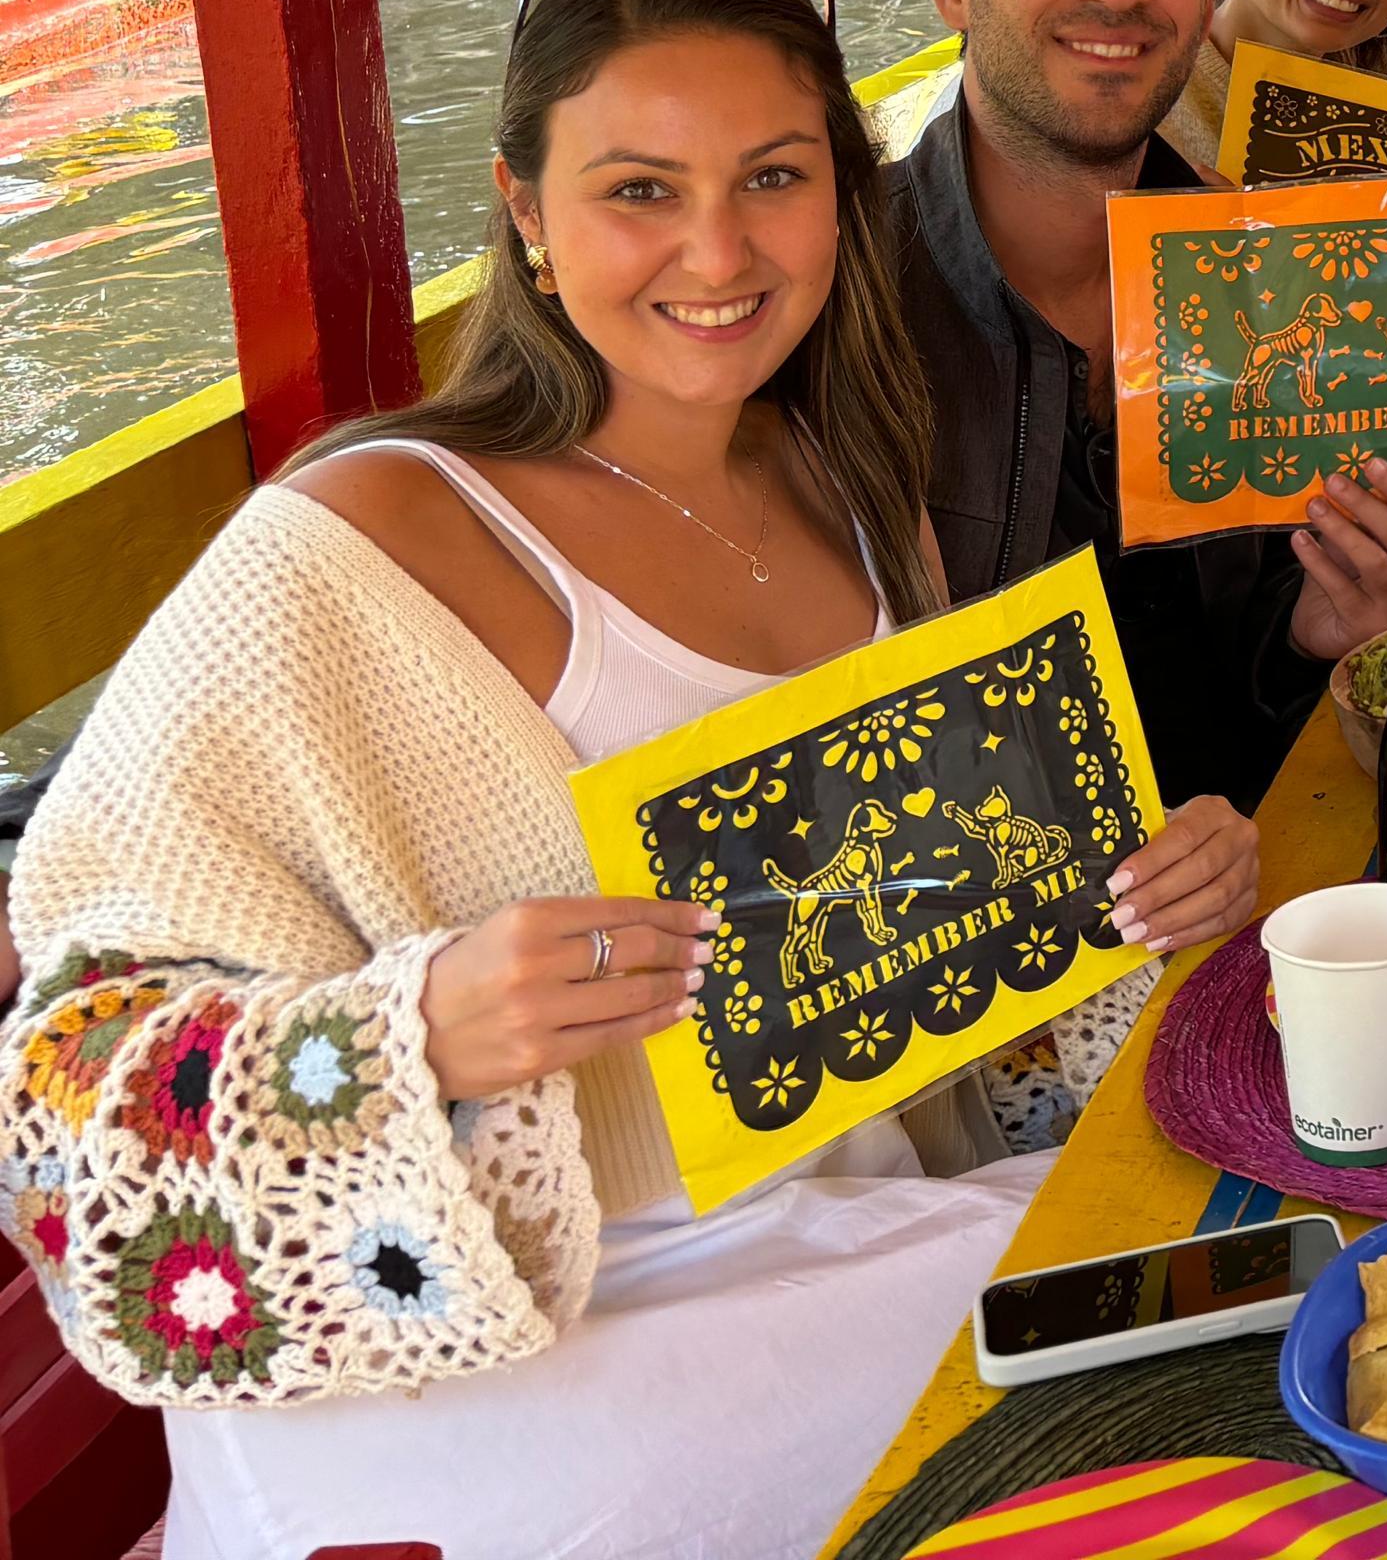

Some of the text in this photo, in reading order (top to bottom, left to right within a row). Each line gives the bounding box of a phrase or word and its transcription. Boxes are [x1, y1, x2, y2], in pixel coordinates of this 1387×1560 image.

[787, 858, 1087, 1029] REMEMBER ME
[1294, 1114, 1378, 1141] ecotainer
